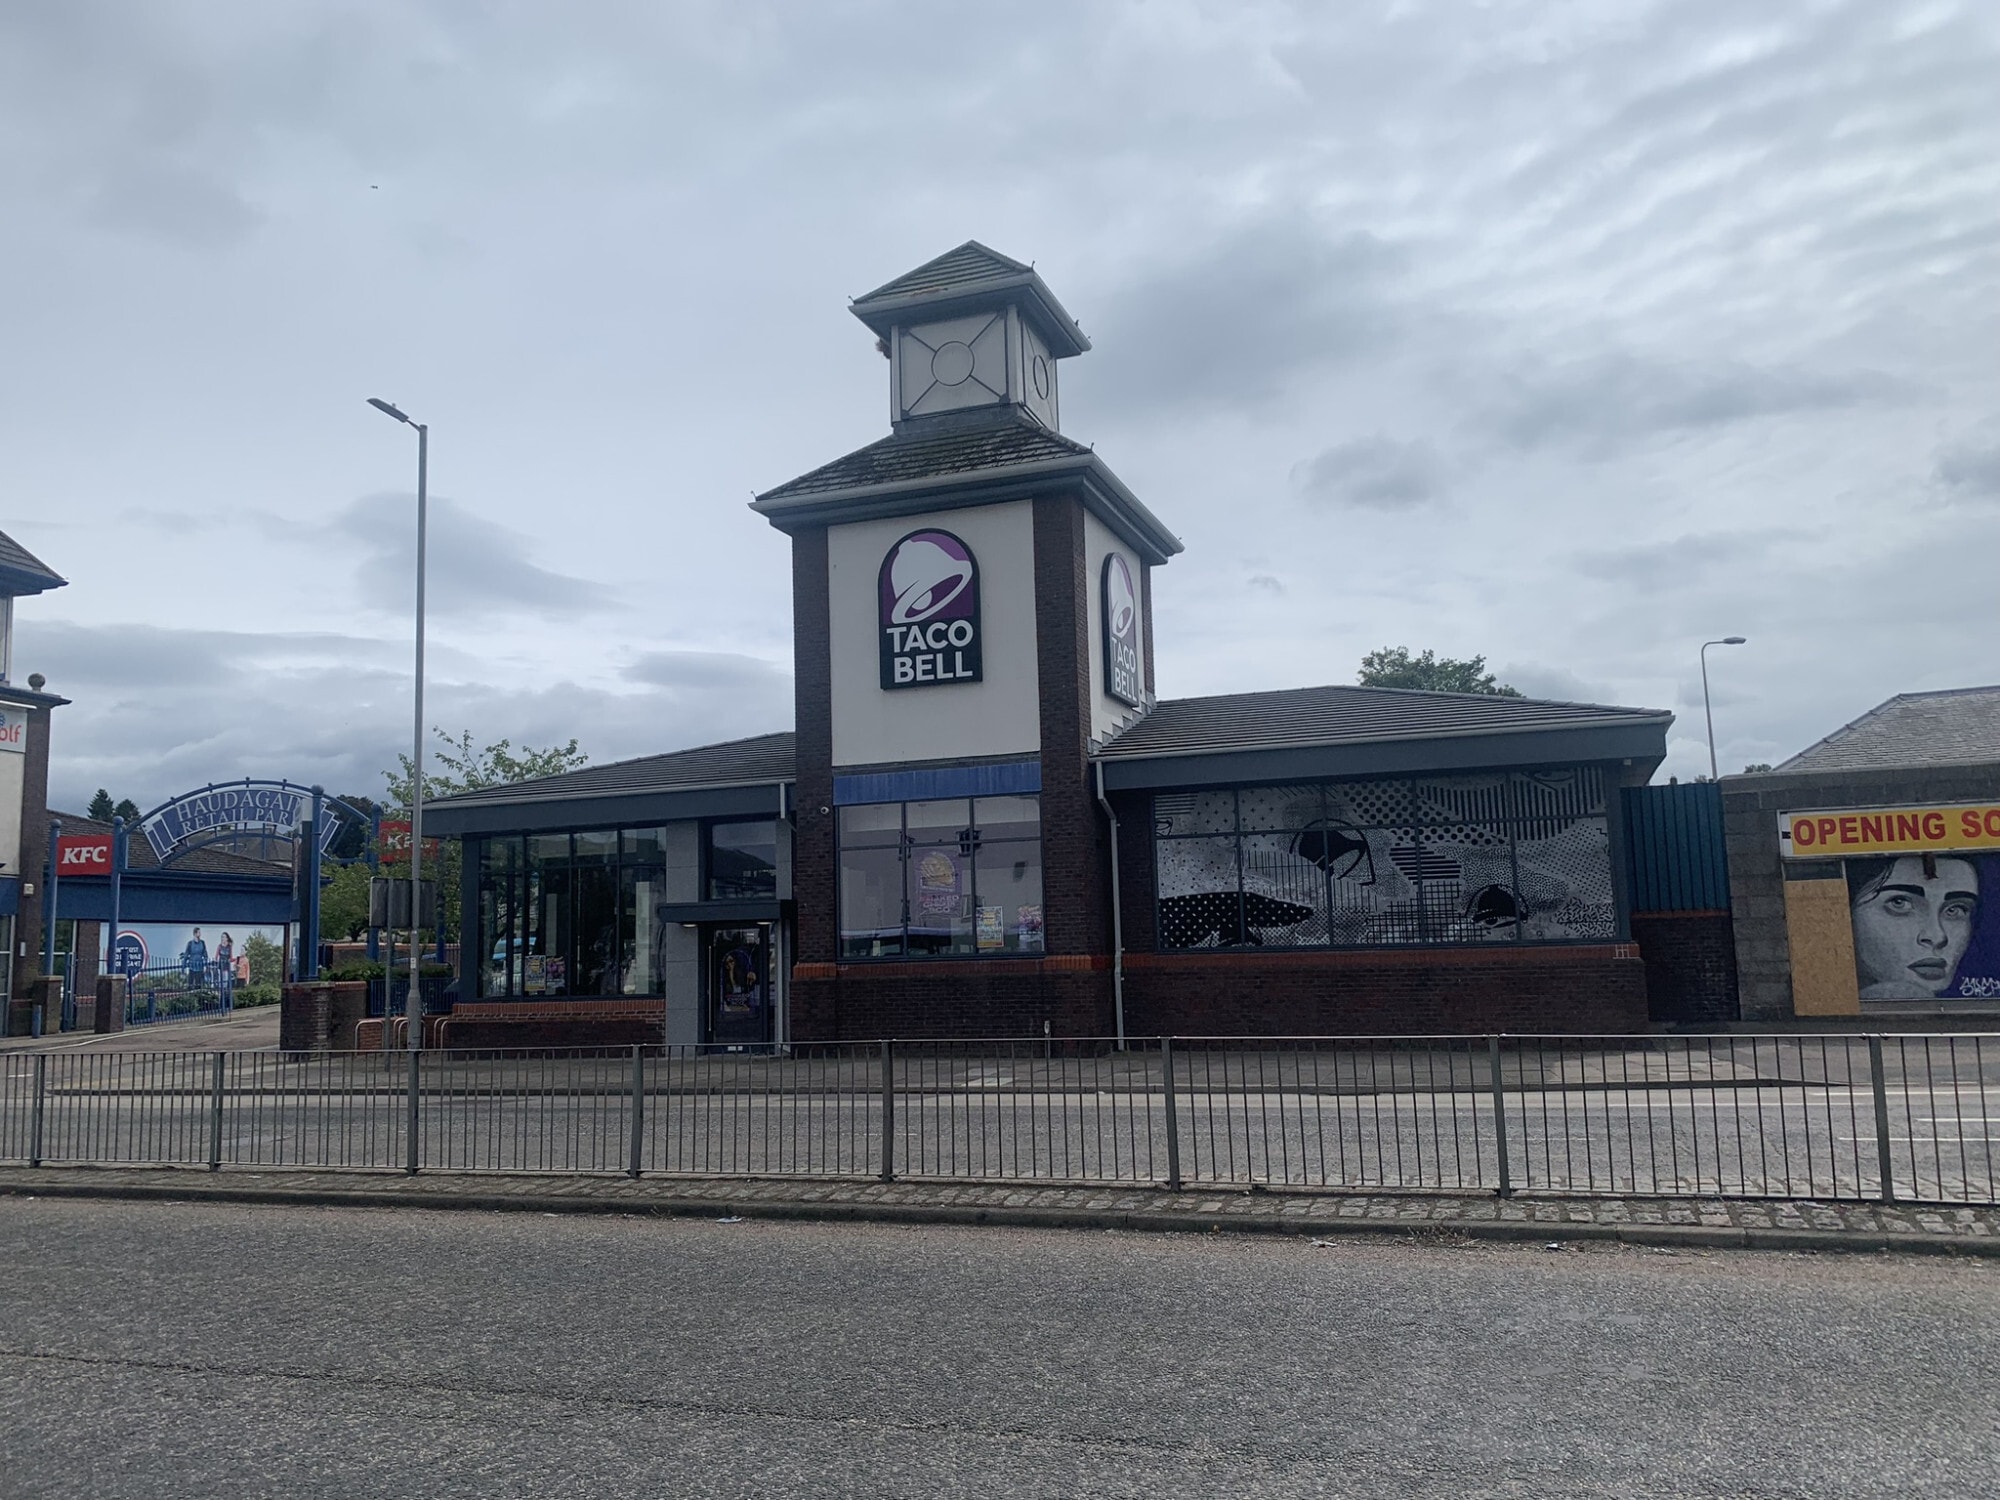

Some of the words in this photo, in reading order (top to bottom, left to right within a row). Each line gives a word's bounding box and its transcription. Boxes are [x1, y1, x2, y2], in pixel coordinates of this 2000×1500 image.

[886, 620, 974, 653] TACO
[894, 651, 973, 683] BELL
[1111, 636, 1136, 674] TACO
[1114, 667, 1137, 702] BELL
[181, 808, 249, 834] RETAIL
[255, 808, 296, 827] PAR
[1793, 813, 1946, 846] OPENING
[1961, 809, 2000, 838] SO
[61, 846, 107, 864] KFC
[387, 832, 432, 849] KF
